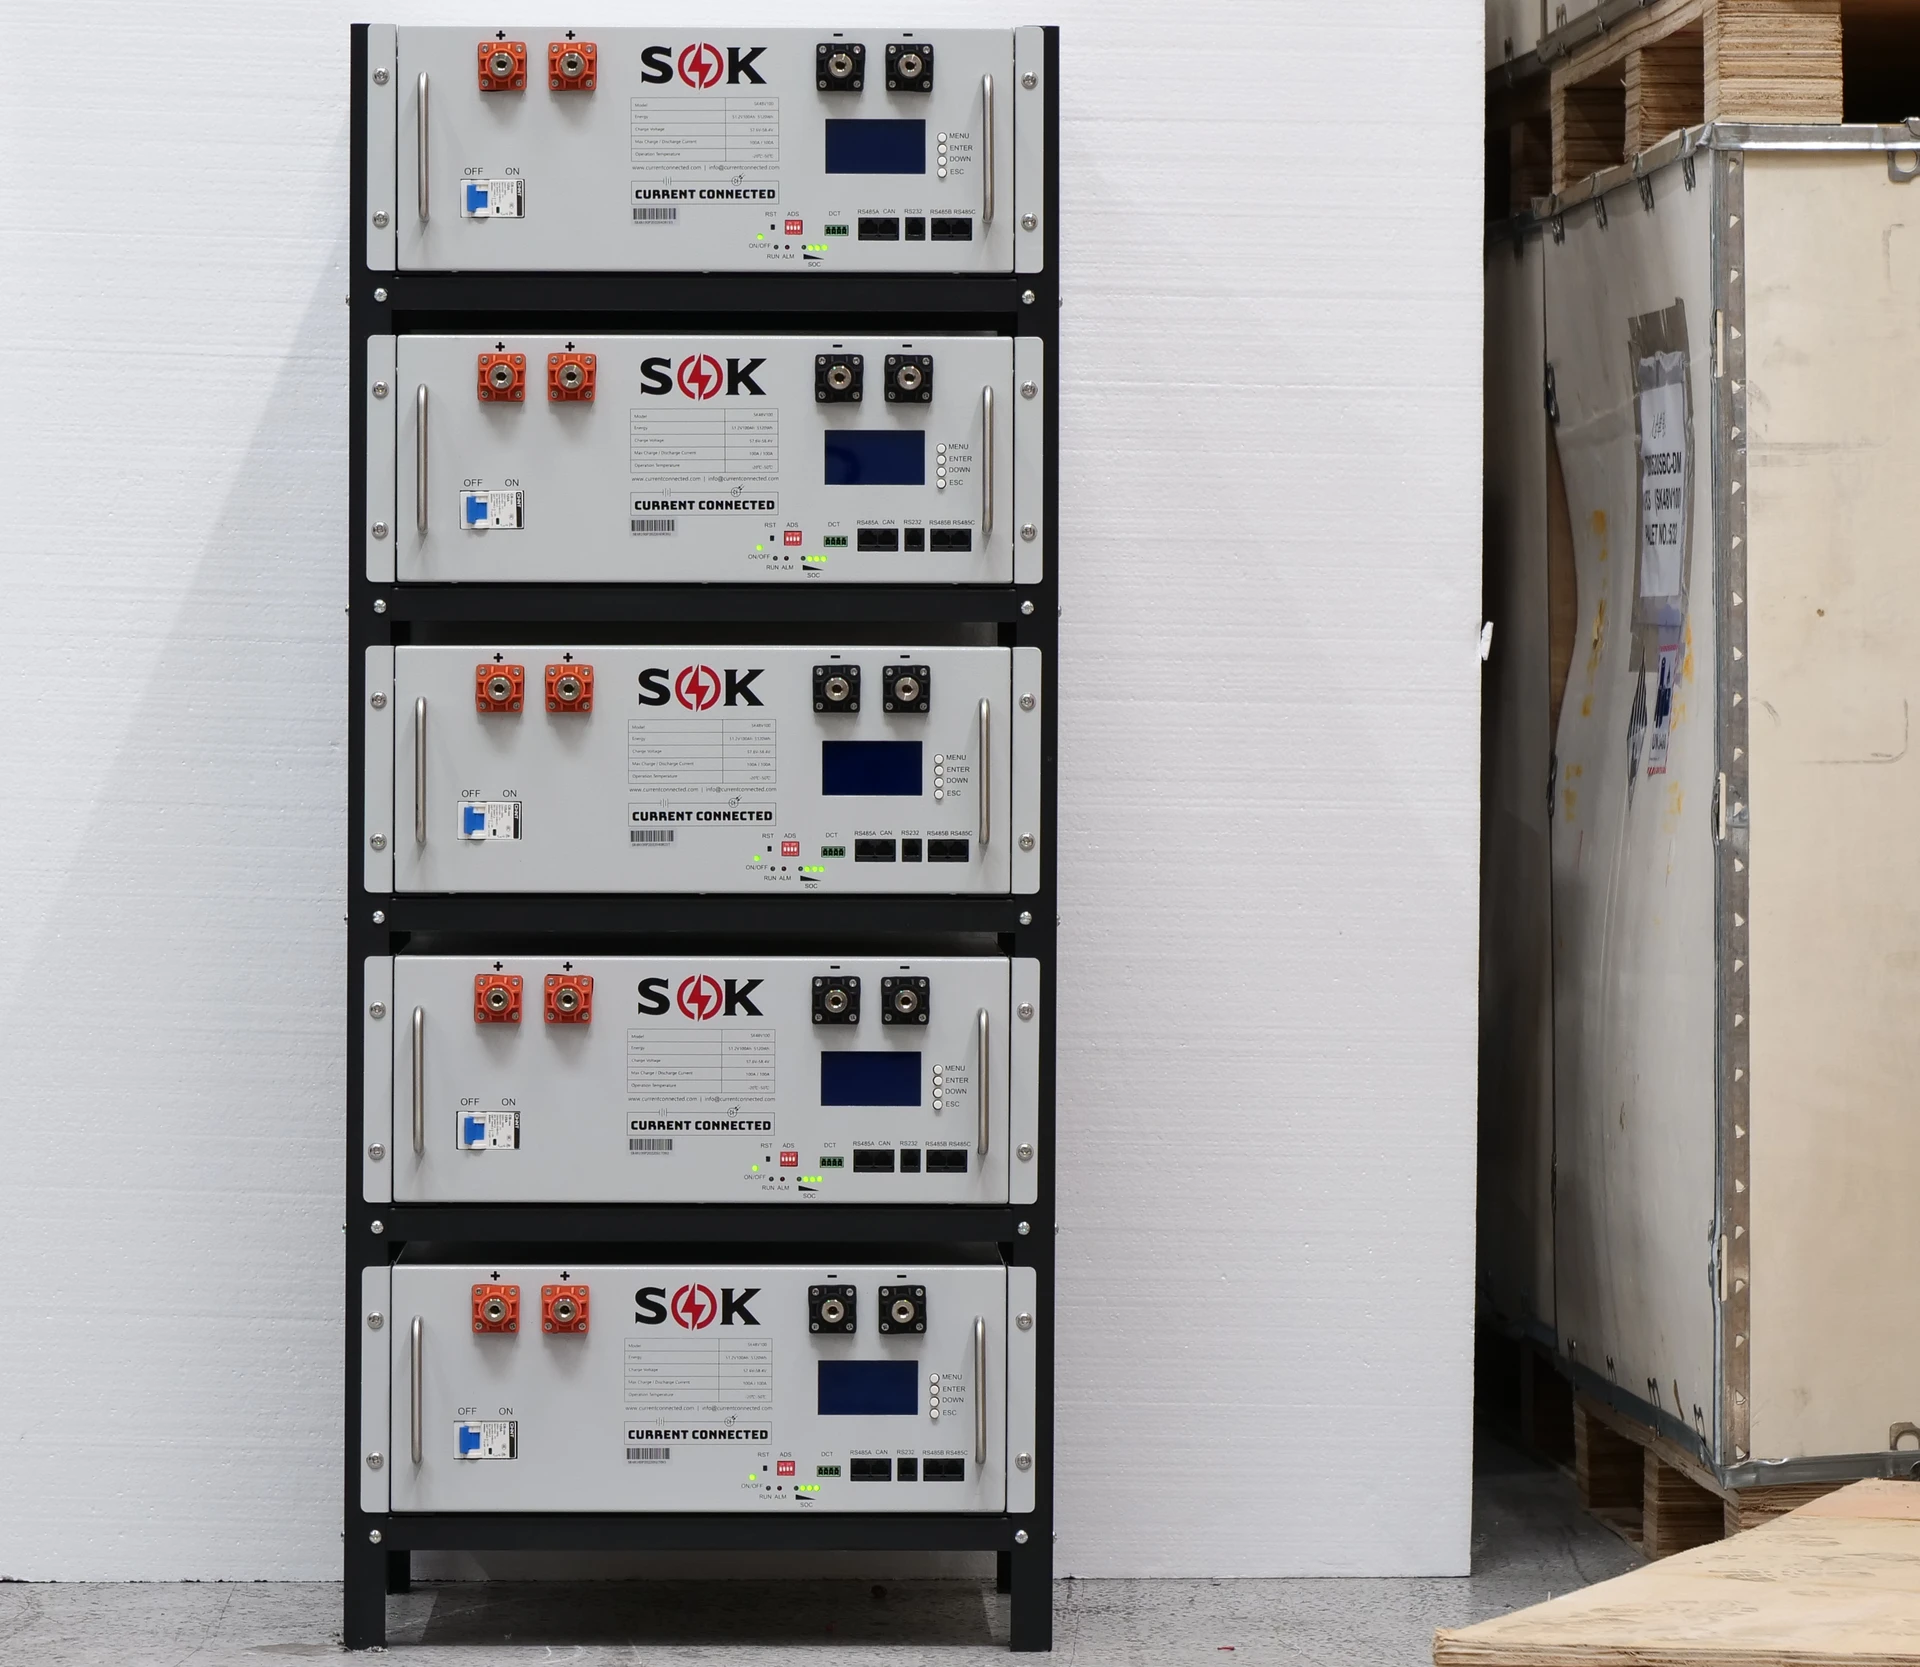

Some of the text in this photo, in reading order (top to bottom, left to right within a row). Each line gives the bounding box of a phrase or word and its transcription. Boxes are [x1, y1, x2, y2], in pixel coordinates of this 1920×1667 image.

[464, 167, 520, 176] OFF ON
[635, 189, 776, 199] CURRENT CONNECTED
[464, 478, 520, 487] OFF ON
[634, 500, 775, 510] CURRENT CONNECTED
[461, 789, 517, 798] OFF ON
[632, 811, 773, 821] CURRENT CONNECTED
[460, 1098, 516, 1106] OFF ON
[631, 1120, 772, 1130] CURRENT CONNECTED
[458, 1407, 514, 1416] OFF ON
[628, 1429, 769, 1440] CURRENT CONNECTED
